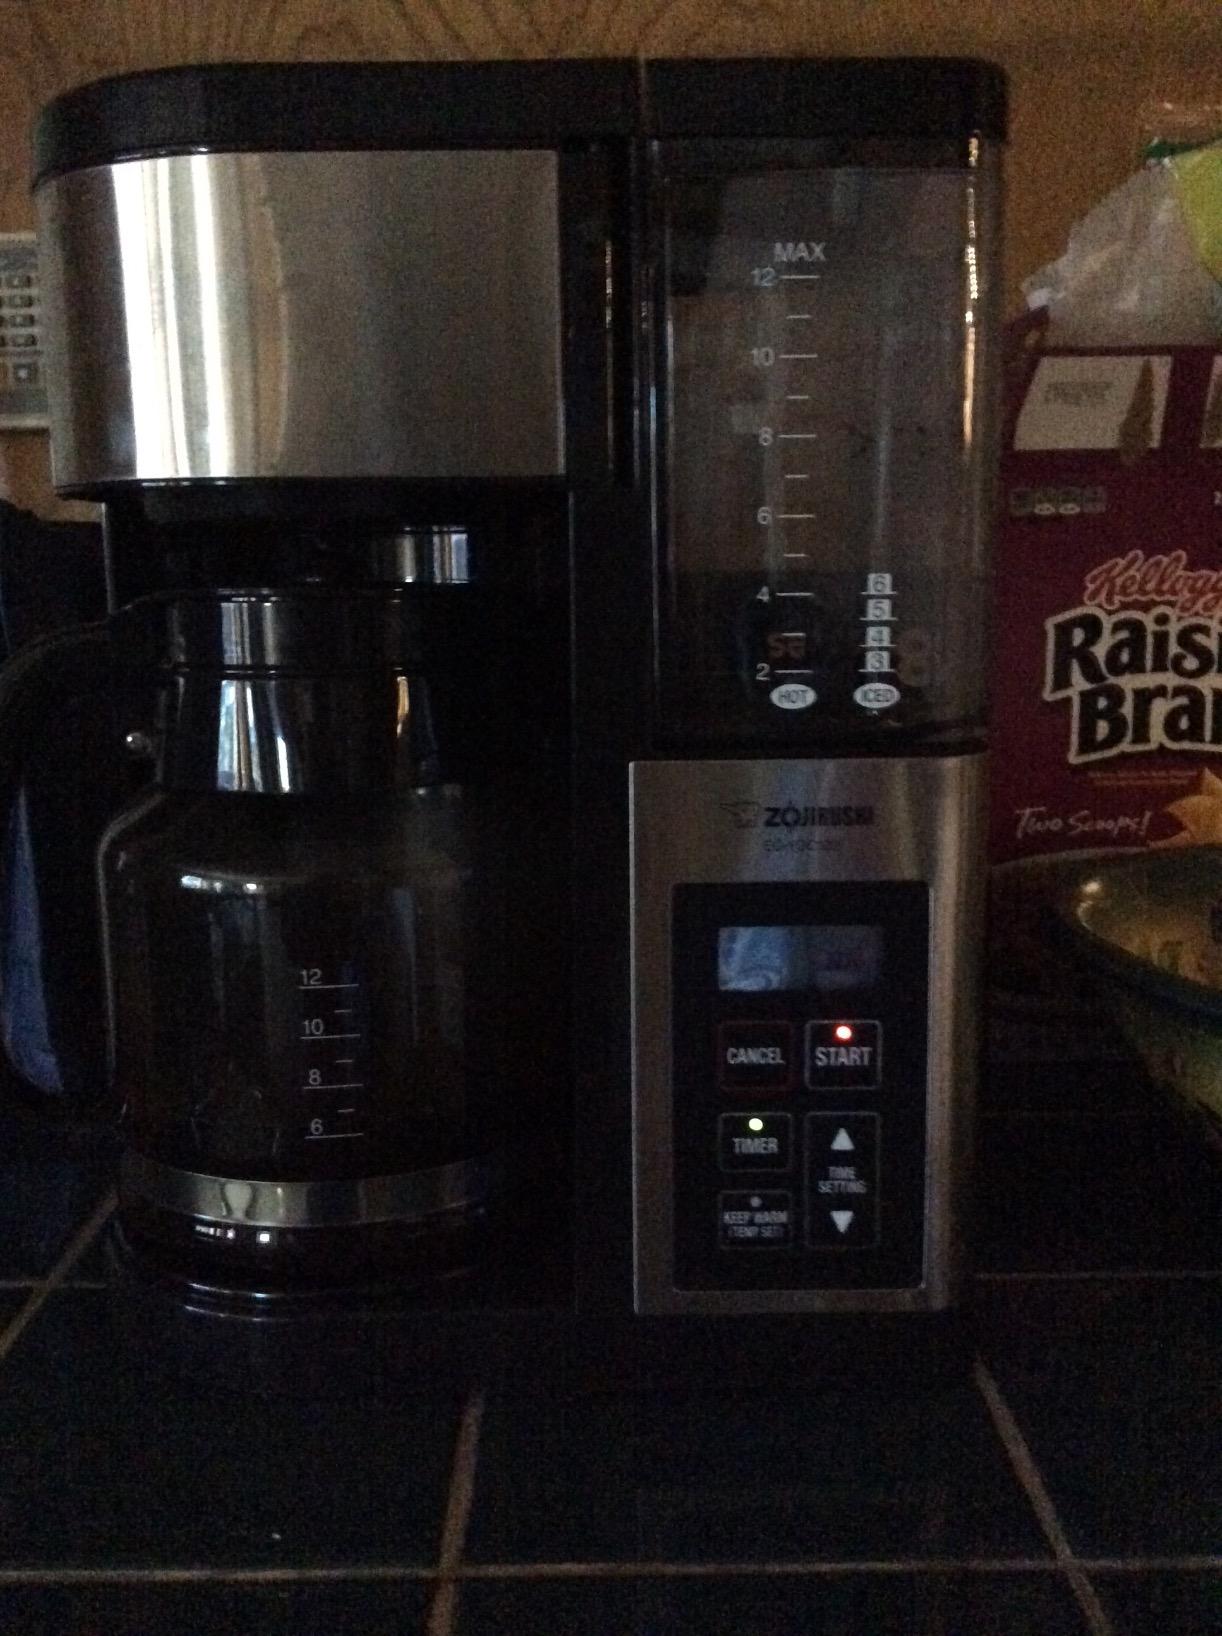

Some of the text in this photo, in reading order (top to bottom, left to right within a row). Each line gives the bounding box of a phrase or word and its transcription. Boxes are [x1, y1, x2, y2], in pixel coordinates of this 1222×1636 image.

[773, 242, 827, 262] MAX
[751, 266, 777, 287] 12
[752, 347, 775, 367] 10
[758, 426, 774, 446] 8
[757, 506, 772, 525] 6
[756, 585, 770, 603] 4
[1048, 608, 1222, 690] Rais
[755, 663, 771, 682] 2
[1074, 682, 1222, 758] Bra
[1015, 806, 1063, 839] Two
[301, 968, 322, 985] 12
[304, 1018, 324, 1035] 10
[726, 1047, 785, 1065] CANCEL
[815, 1046, 873, 1067] START
[308, 1068, 322, 1085] 8
[310, 1118, 324, 1135] 6
[733, 1136, 779, 1155] TIMER
